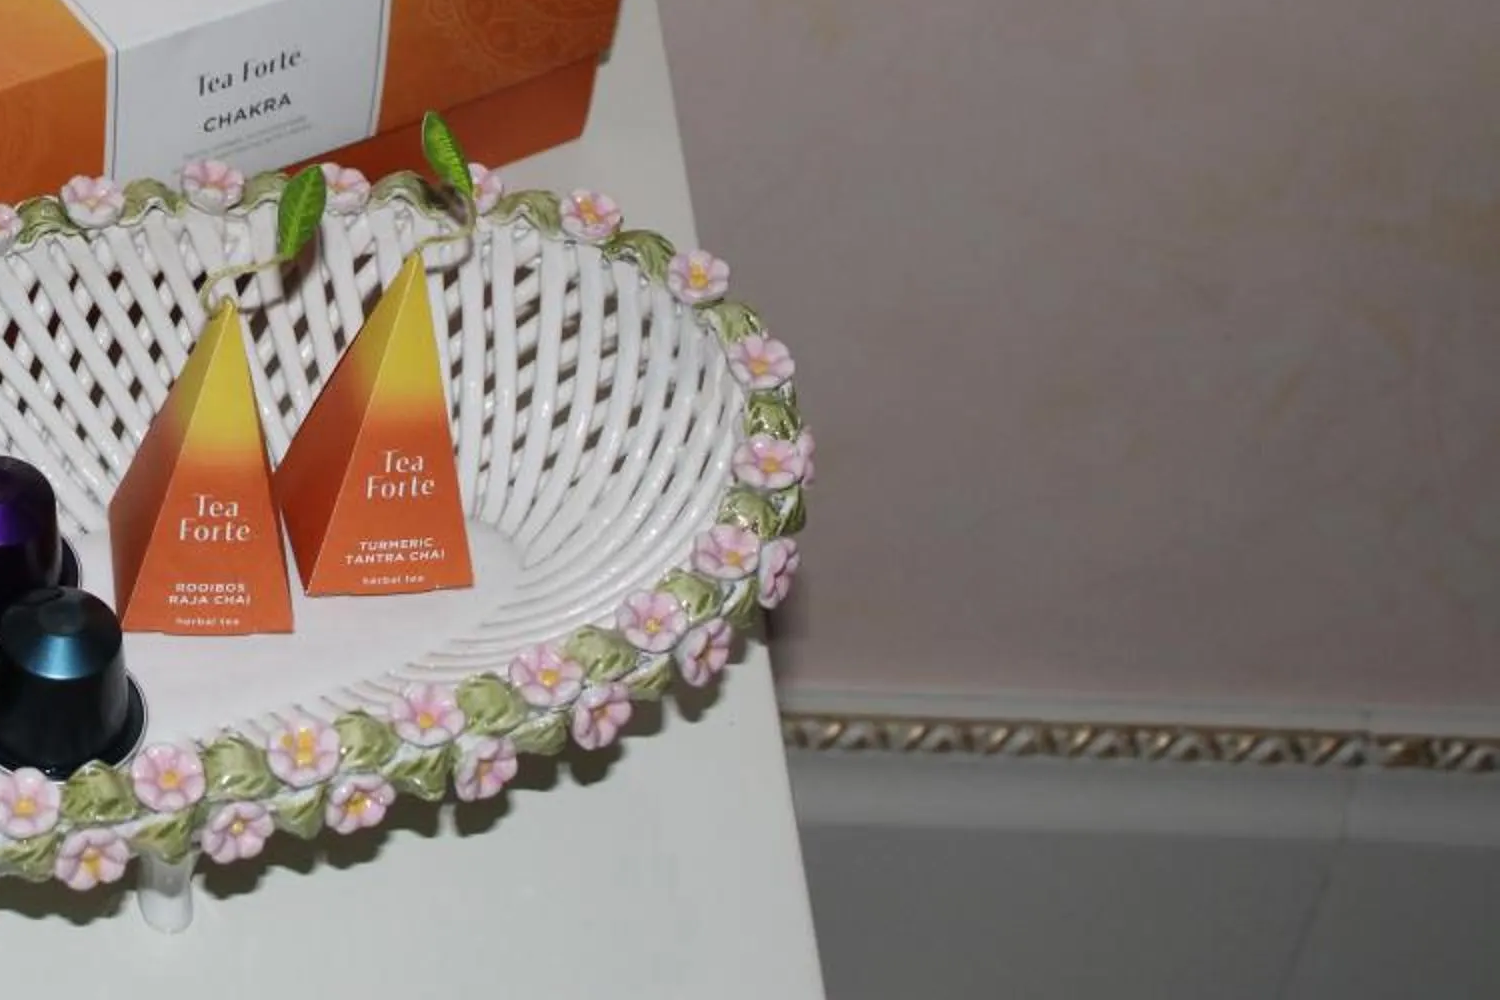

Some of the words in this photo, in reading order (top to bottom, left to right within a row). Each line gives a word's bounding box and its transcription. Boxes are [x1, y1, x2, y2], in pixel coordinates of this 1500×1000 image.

[198, 72, 233, 97] Tea
[203, 93, 292, 132] CHAKRA
[381, 449, 424, 473] Tea
[193, 493, 239, 517] Tea
[360, 537, 434, 551] TURMERIC
[344, 553, 405, 565] TANTRA
[409, 548, 445, 562] CHAI
[175, 583, 246, 593] ROOIBOS
[168, 595, 209, 605] RAJA
[214, 594, 251, 606] CHAI
